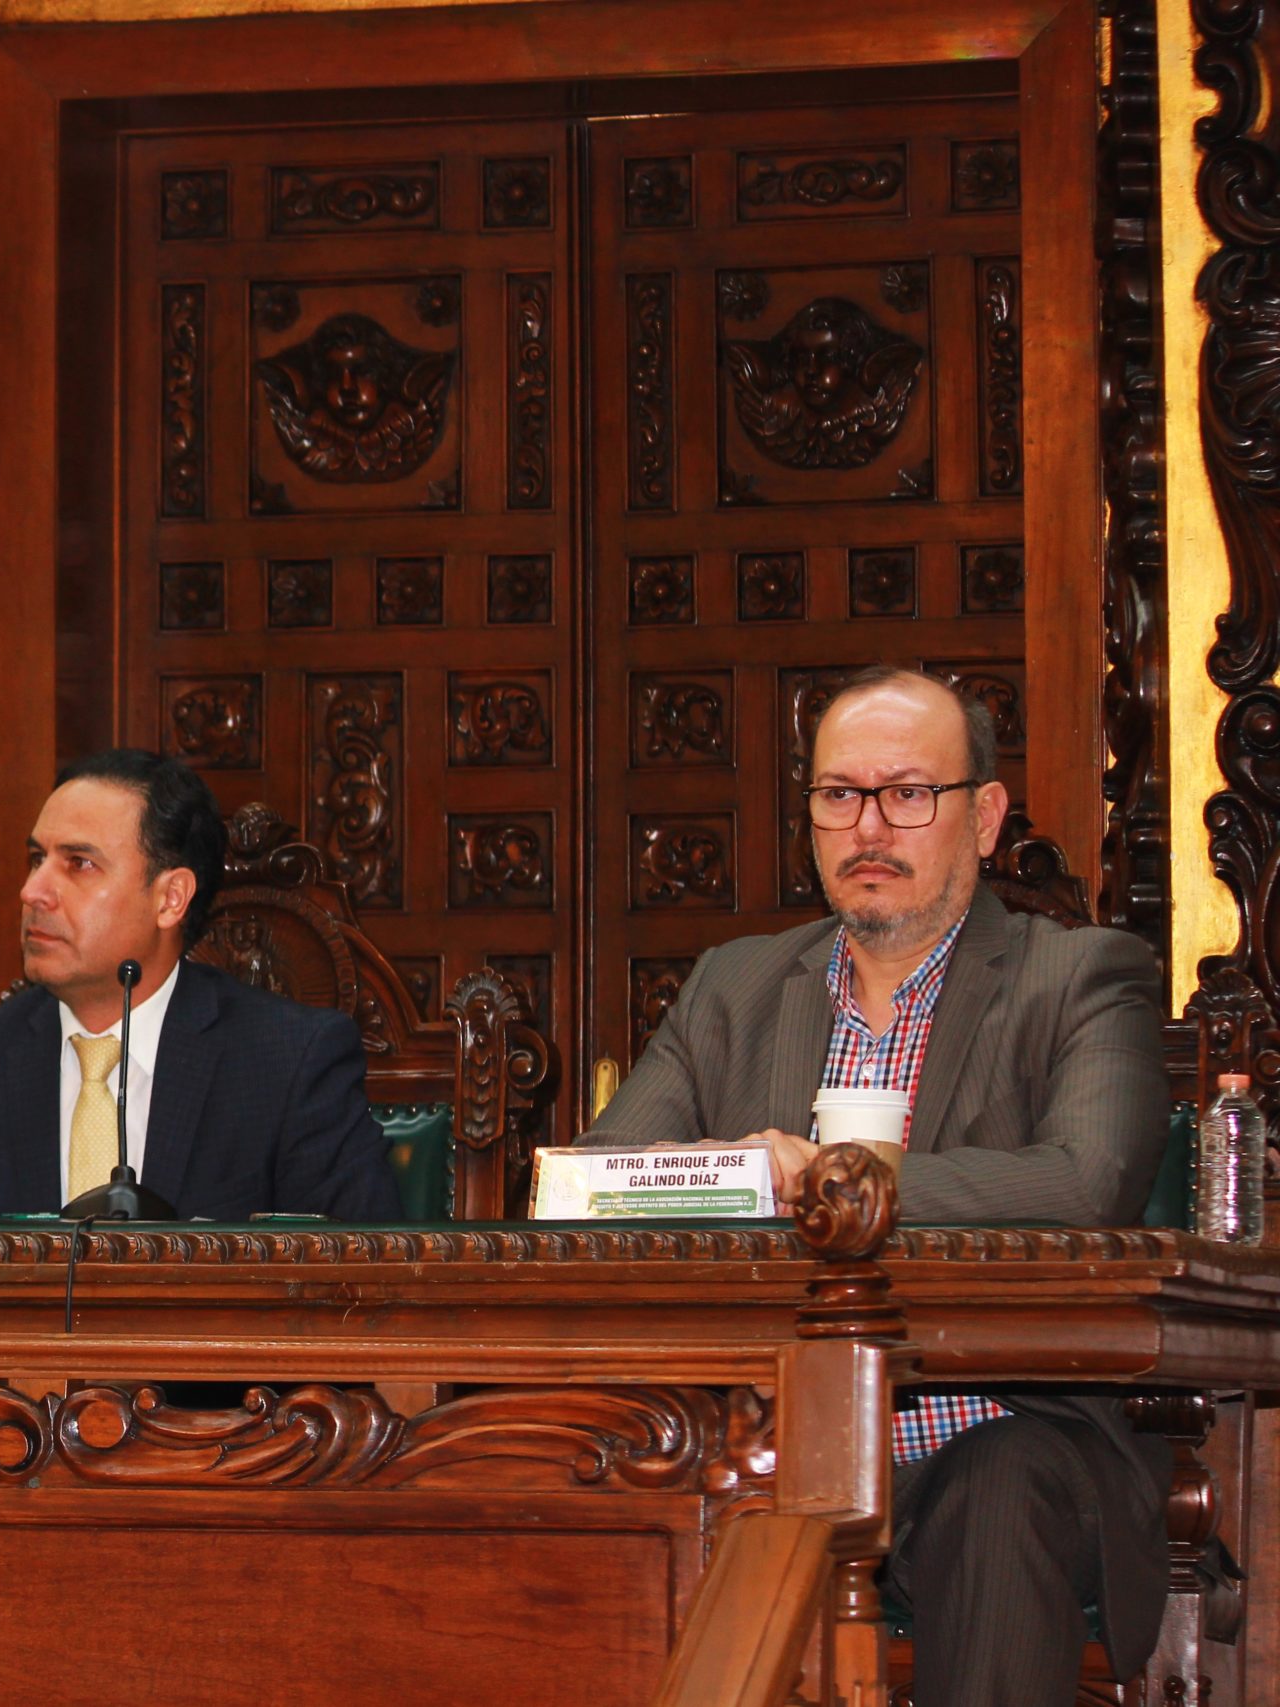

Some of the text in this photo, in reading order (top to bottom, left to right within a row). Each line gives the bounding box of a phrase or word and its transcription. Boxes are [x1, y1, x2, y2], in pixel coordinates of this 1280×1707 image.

[606, 1152, 746, 1170] MTRO. ENRIQUE JOSÉ
[629, 1170, 719, 1187] GALINDO DÍAZ
